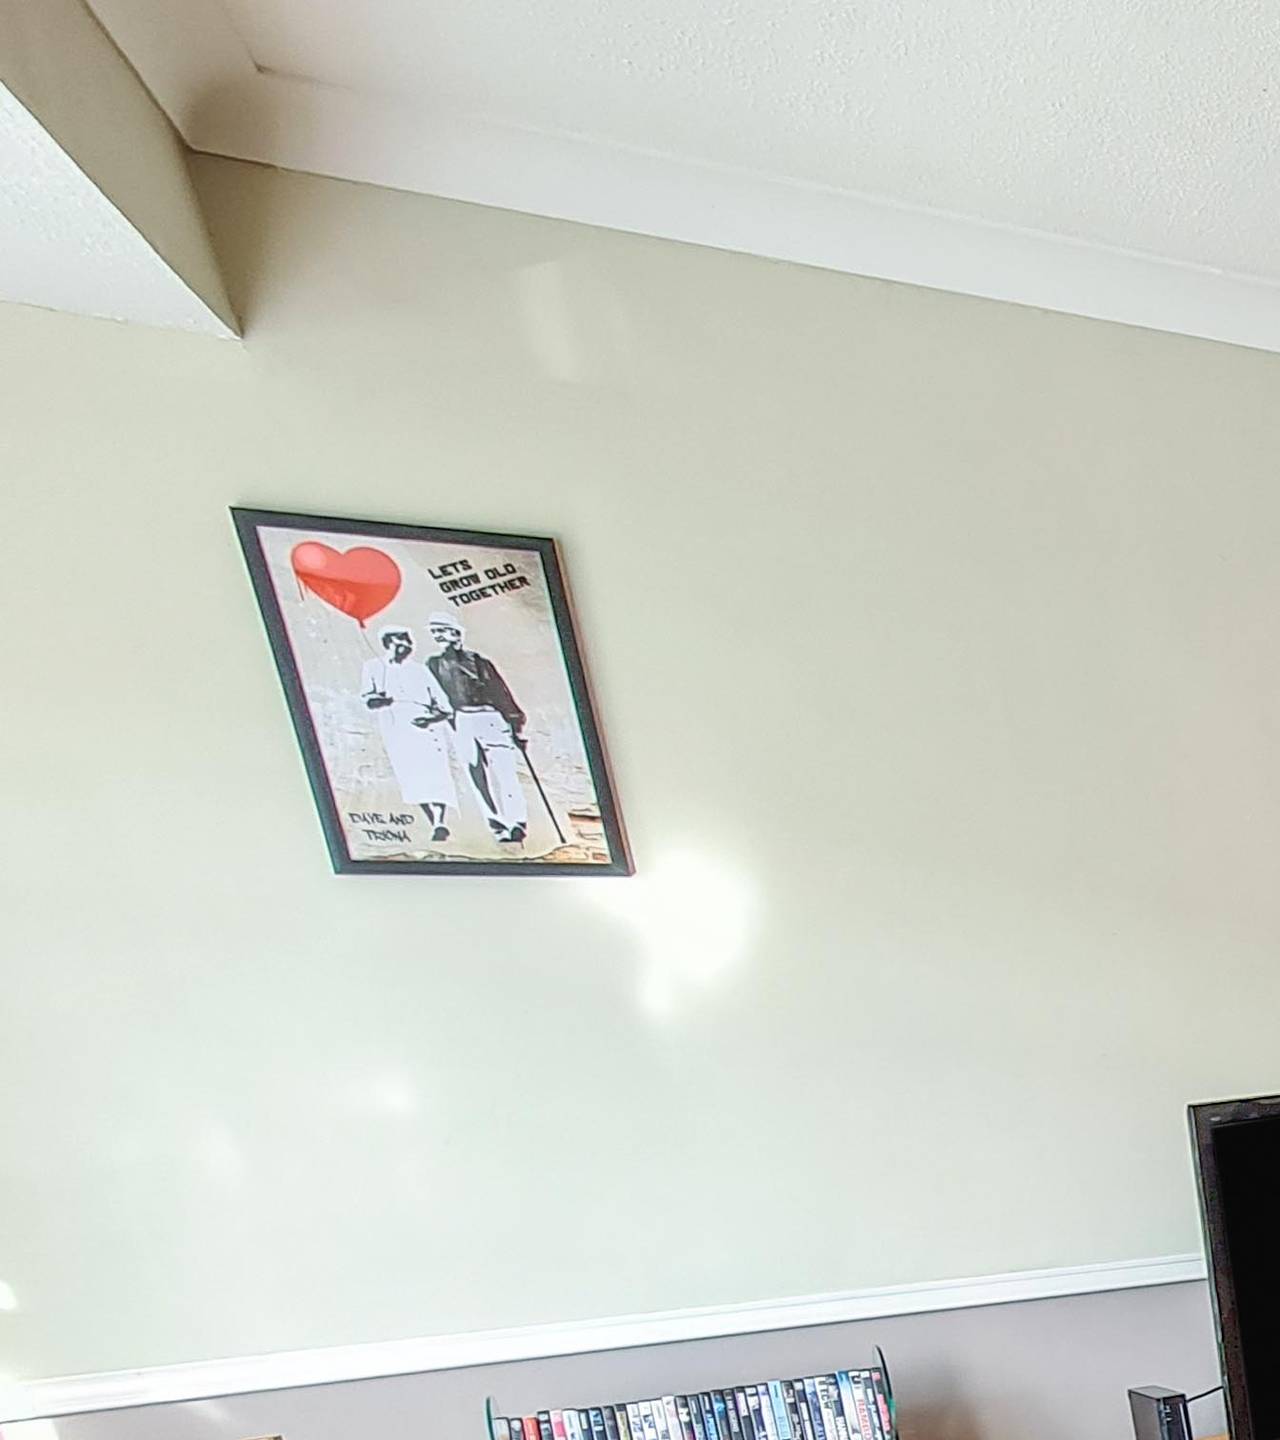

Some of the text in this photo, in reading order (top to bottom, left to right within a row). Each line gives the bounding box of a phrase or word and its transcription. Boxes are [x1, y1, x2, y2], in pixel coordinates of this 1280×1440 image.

[427, 559, 472, 579] LETS
[439, 563, 517, 593] GROW OLD
[448, 576, 531, 607] TOGETHER
[389, 812, 416, 825] AND
